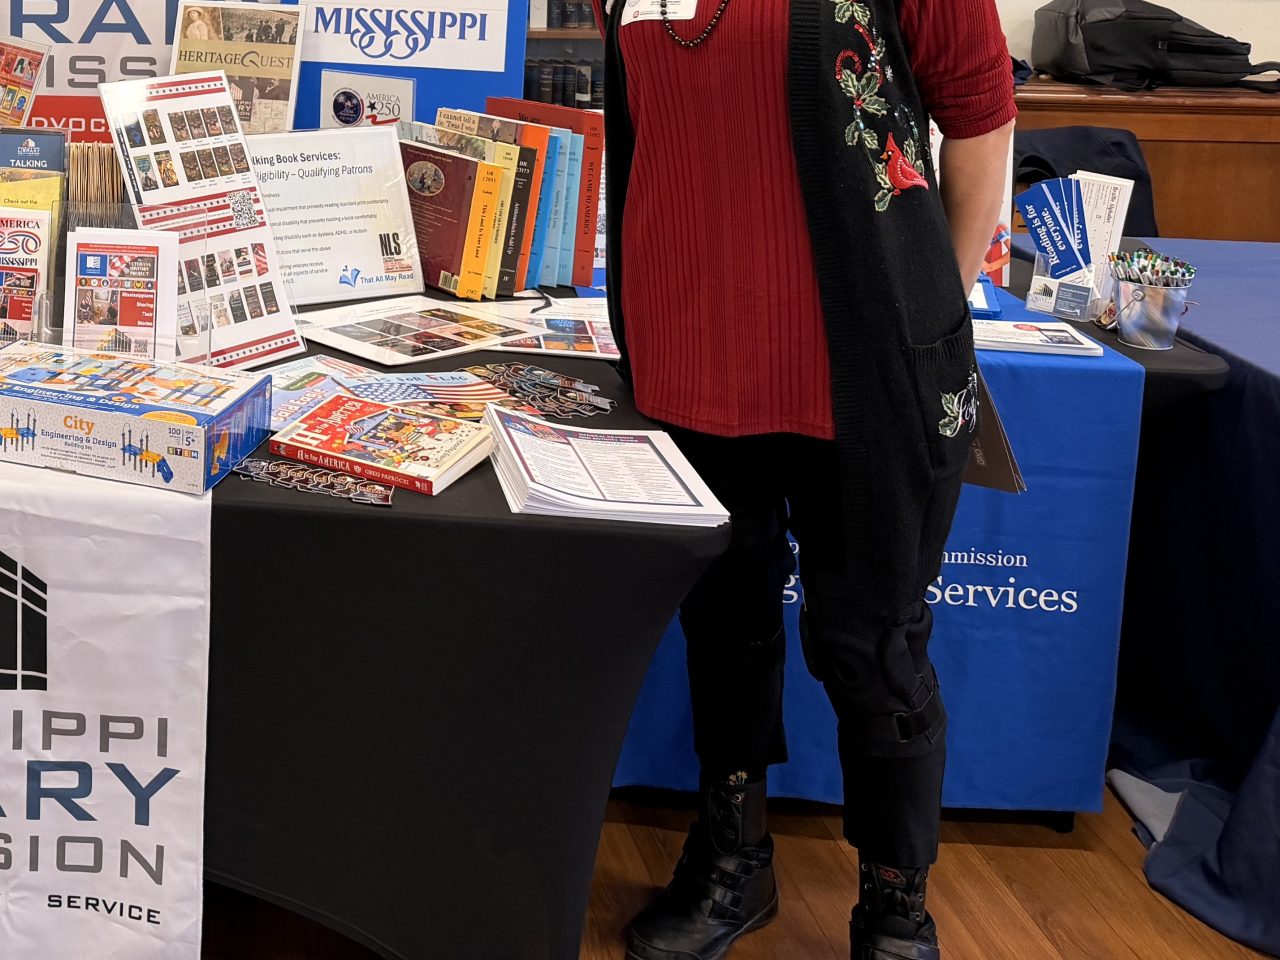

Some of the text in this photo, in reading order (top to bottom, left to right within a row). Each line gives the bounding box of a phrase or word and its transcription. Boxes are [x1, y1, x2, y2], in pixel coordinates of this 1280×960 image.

[313, 6, 488, 60] MISSISSIPPI
[365, 92, 400, 104] AMERICA
[377, 101, 400, 117] 250
[10, 159, 47, 168] TALKING
[253, 152, 341, 166] lking Book Services:
[297, 166, 340, 178] Qualifying
[341, 165, 373, 174] Patrons
[1025, 205, 1037, 219] for
[379, 233, 402, 256] NLS
[1037, 227, 1060, 266] Reading
[360, 276, 375, 284] That
[384, 274, 397, 283] May
[63, 415, 95, 434] City
[168, 427, 181, 436] 100
[41, 429, 84, 444] Engineering
[92, 437, 117, 449] Design
[310, 455, 318, 463] for
[318, 456, 351, 472] AMERICA
[364, 469, 380, 477] GREG
[47, 893, 162, 925] SERVICE
